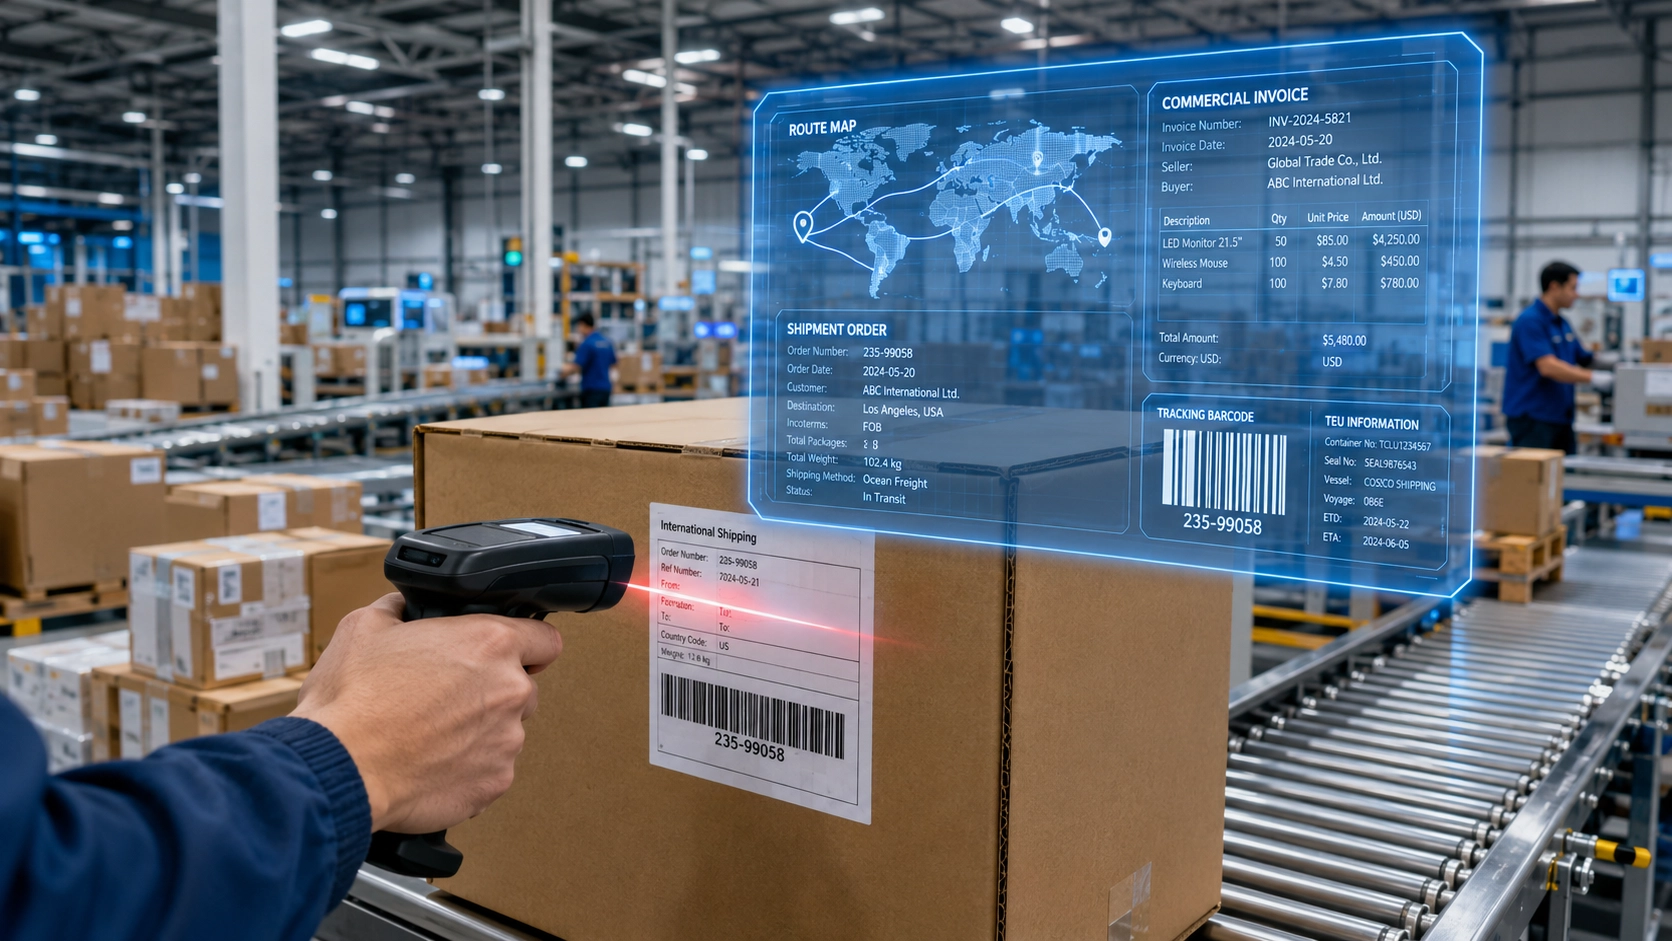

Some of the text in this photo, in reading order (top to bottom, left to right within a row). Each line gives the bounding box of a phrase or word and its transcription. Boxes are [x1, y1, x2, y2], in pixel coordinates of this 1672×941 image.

[1162, 87, 1309, 109] COMMERCIAL INVOICE
[1162, 118, 1242, 133] Invoice Number:
[1269, 112, 1351, 127] INV-2024-5821
[789, 119, 856, 136] ROUTE MAP
[1161, 139, 1225, 152] Invoice Date:
[1268, 134, 1333, 148] 2024-05-20
[1161, 161, 1192, 172] Seller:
[1268, 152, 1382, 169] Global Trade Co., Ltd.
[1267, 173, 1383, 189] ABC International Ltd.
[1161, 181, 1193, 194] Buyer:
[1164, 215, 1210, 228] Description
[1271, 213, 1287, 226] Qty
[1307, 212, 1349, 223] Unit Price
[1362, 210, 1422, 222] Amount (USD)
[1163, 236, 1242, 249] LED Monitor 21.5"
[1275, 236, 1287, 247] 50
[1317, 235, 1348, 247] $85.00
[1373, 233, 1420, 246] $4,250.00
[1162, 258, 1228, 269] Wireless Mouse
[1270, 257, 1287, 268] 100
[1322, 256, 1348, 268] $4.50
[1381, 255, 1420, 267] $450.00
[1162, 278, 1202, 291] Keyboard
[1270, 278, 1287, 289] 100
[1322, 277, 1348, 289] $7.80
[1381, 277, 1419, 289] $780.00
[787, 323, 887, 336] SHIPMENT ORDER
[1160, 332, 1218, 344] Total Amount:
[1323, 335, 1366, 347] $5,480.00
[787, 346, 849, 357] Order Number:
[863, 347, 913, 358] 235-99058
[1159, 353, 1221, 365] Currency: USD:
[1322, 356, 1342, 367] USD
[787, 364, 833, 375] Order Date:
[863, 366, 915, 378] 2024-05-20
[787, 382, 827, 393] Customer:
[863, 385, 960, 399] ABC International Ltd.
[787, 401, 835, 412] Destination:
[863, 404, 944, 418] Los Angeles, USA
[1157, 408, 1254, 422] TRACKING BARCODE
[787, 418, 828, 429] Incoterms:
[863, 422, 882, 432] FOB
[1325, 415, 1419, 430] TEU INFORMATION
[787, 435, 847, 448] Total Packages:
[1325, 437, 1362, 448] Container
[1364, 439, 1377, 449] No:
[787, 452, 838, 465] Total Weight:
[864, 457, 902, 471] 102.4 kg
[1324, 456, 1356, 467] Seal No:
[786, 469, 855, 483] Shipping Method:
[863, 474, 927, 490] Ocean Freight
[1324, 475, 1352, 485] Vessel:
[786, 485, 812, 496] Status:
[1396, 480, 1436, 492] SHIPPING
[863, 492, 906, 505] In Transit
[1323, 494, 1355, 506] Voyage:
[1183, 513, 1262, 535] 235-99058
[1324, 513, 1342, 523] ETD:
[1363, 516, 1409, 529] 2024-05-22
[661, 520, 757, 545] International Shipping
[1323, 532, 1341, 542] ETA:
[1363, 536, 1409, 549] 2024-06-05
[661, 547, 708, 562] Order Number:
[661, 563, 702, 577] Ref Number:
[661, 630, 707, 647] Country Code:
[719, 642, 729, 650] US
[715, 732, 785, 762] 235-99058
